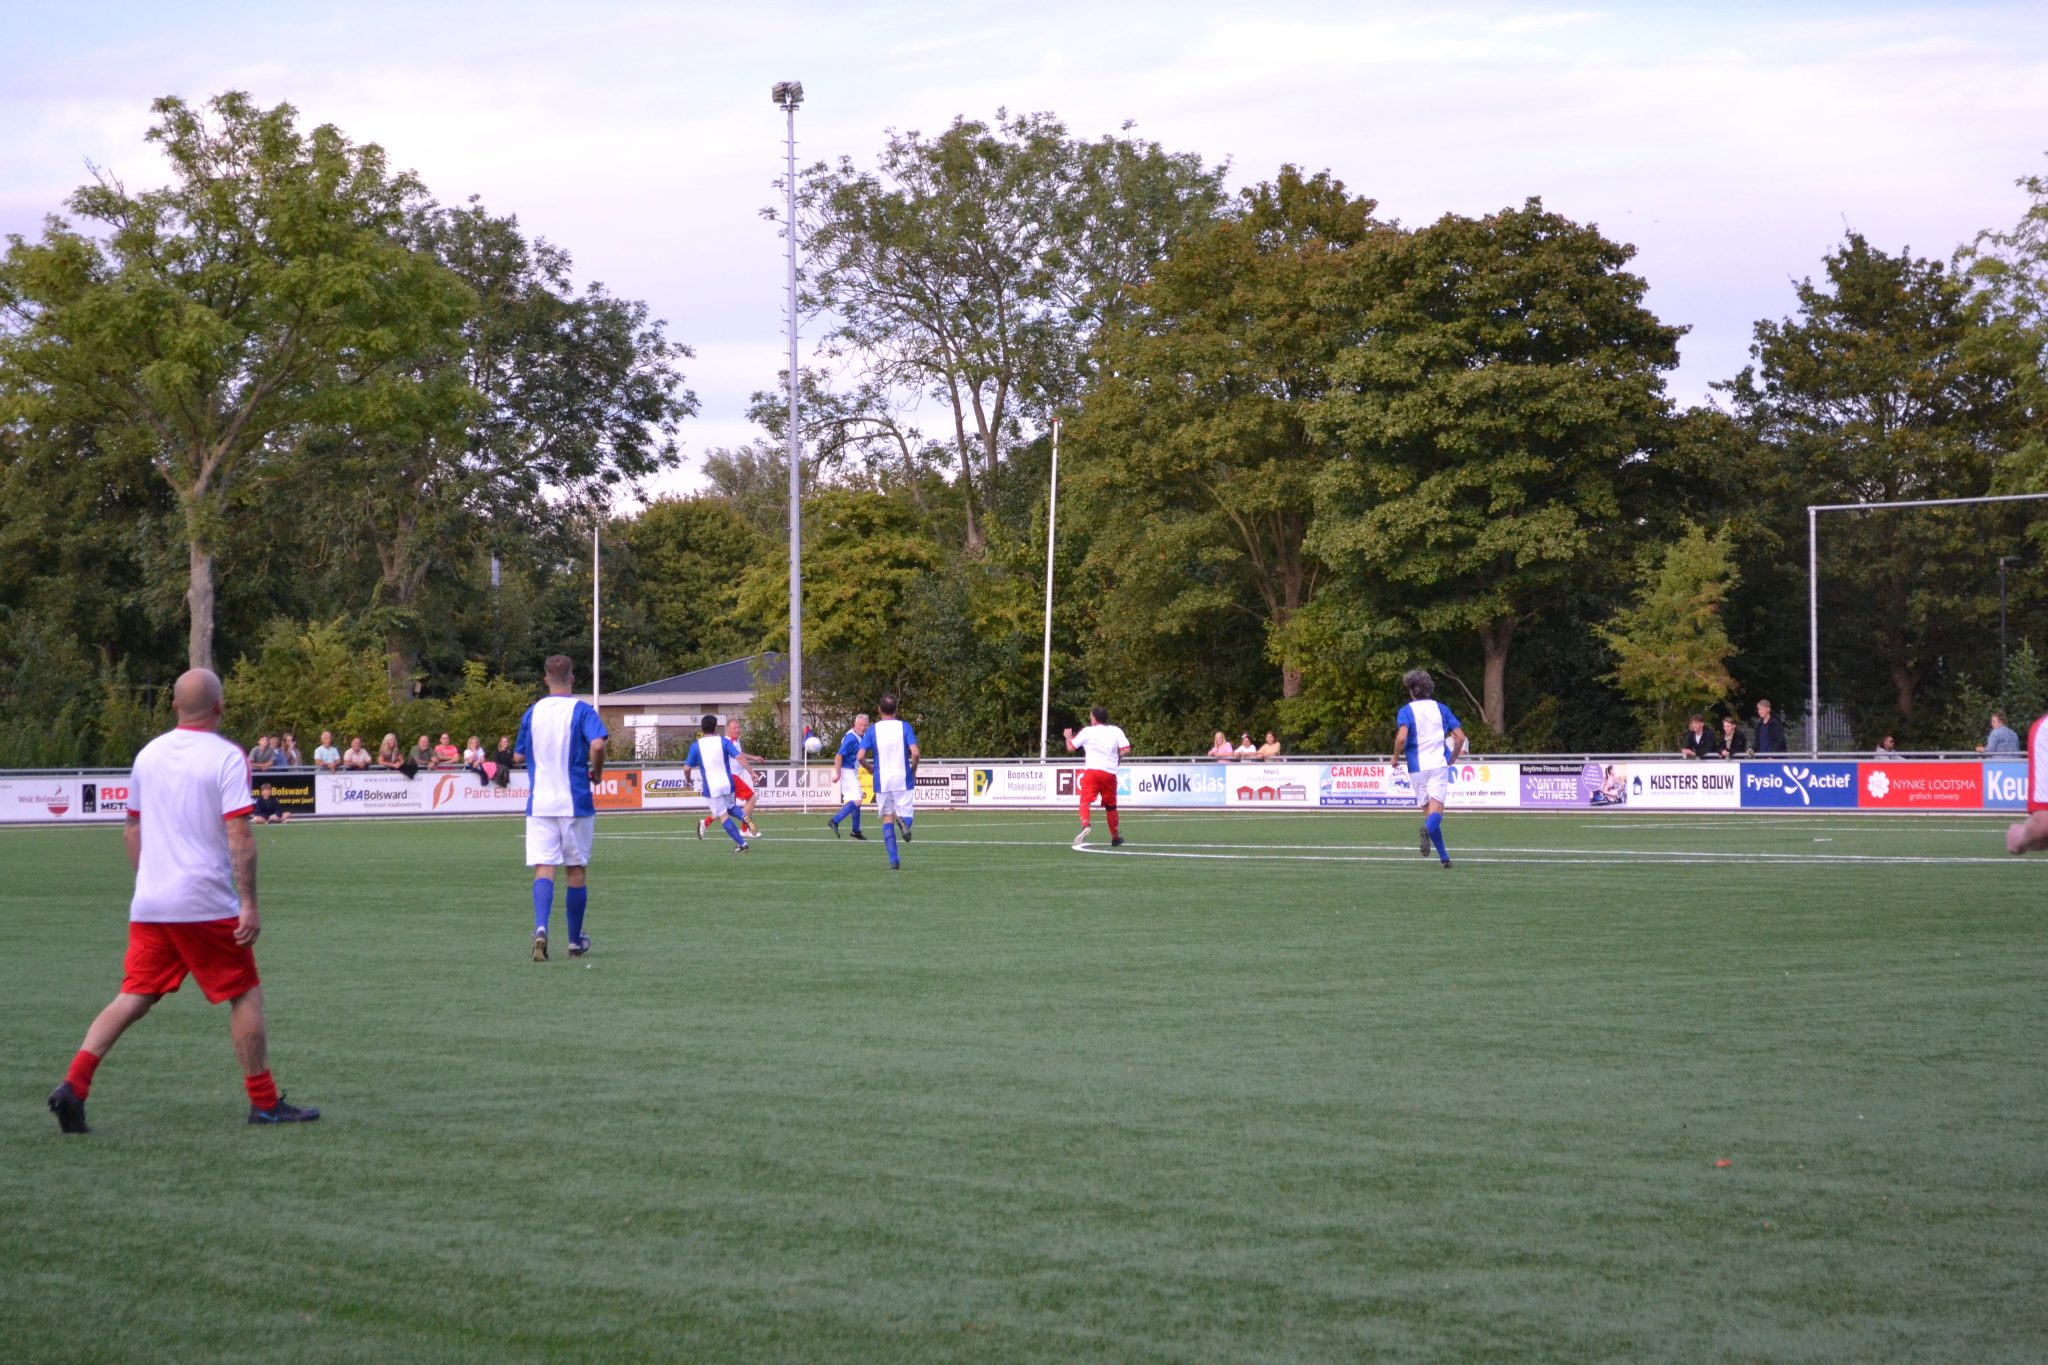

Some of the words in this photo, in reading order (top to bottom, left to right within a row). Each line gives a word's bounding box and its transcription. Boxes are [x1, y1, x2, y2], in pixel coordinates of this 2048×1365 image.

[1007, 770, 1043, 779] Boonstra
[1331, 766, 1385, 777] CARWASH
[1522, 765, 1543, 774] Anytime
[1543, 765, 1560, 773] Fitness
[1560, 764, 1582, 772] Bolsward
[1336, 781, 1380, 789] BOLSWARD
[1536, 777, 1578, 790] ANYTIME
[1650, 775, 1699, 790] KUSTERS
[1701, 775, 1735, 790] BOUW
[1746, 773, 1783, 791] Fysio
[1808, 773, 1851, 788] Actief
[1893, 779, 1926, 790] NYNKE
[1928, 779, 1977, 790] LOOTSMA
[1987, 770, 2028, 801] Keu
[100, 787, 128, 800] RO
[271, 786, 309, 796] Bolsward
[464, 787, 490, 799] Parc
[494, 787, 530, 799] Estate
[1007, 782, 1047, 794] Makelaardij
[35, 795, 70, 803] Bolsward
[801, 790, 832, 798] BOUW
[914, 788, 950, 801] OLKERTS
[1536, 790, 1578, 800] FITNESS
[1908, 792, 1933, 801] grafisch
[1933, 793, 1960, 801] ontwerp
